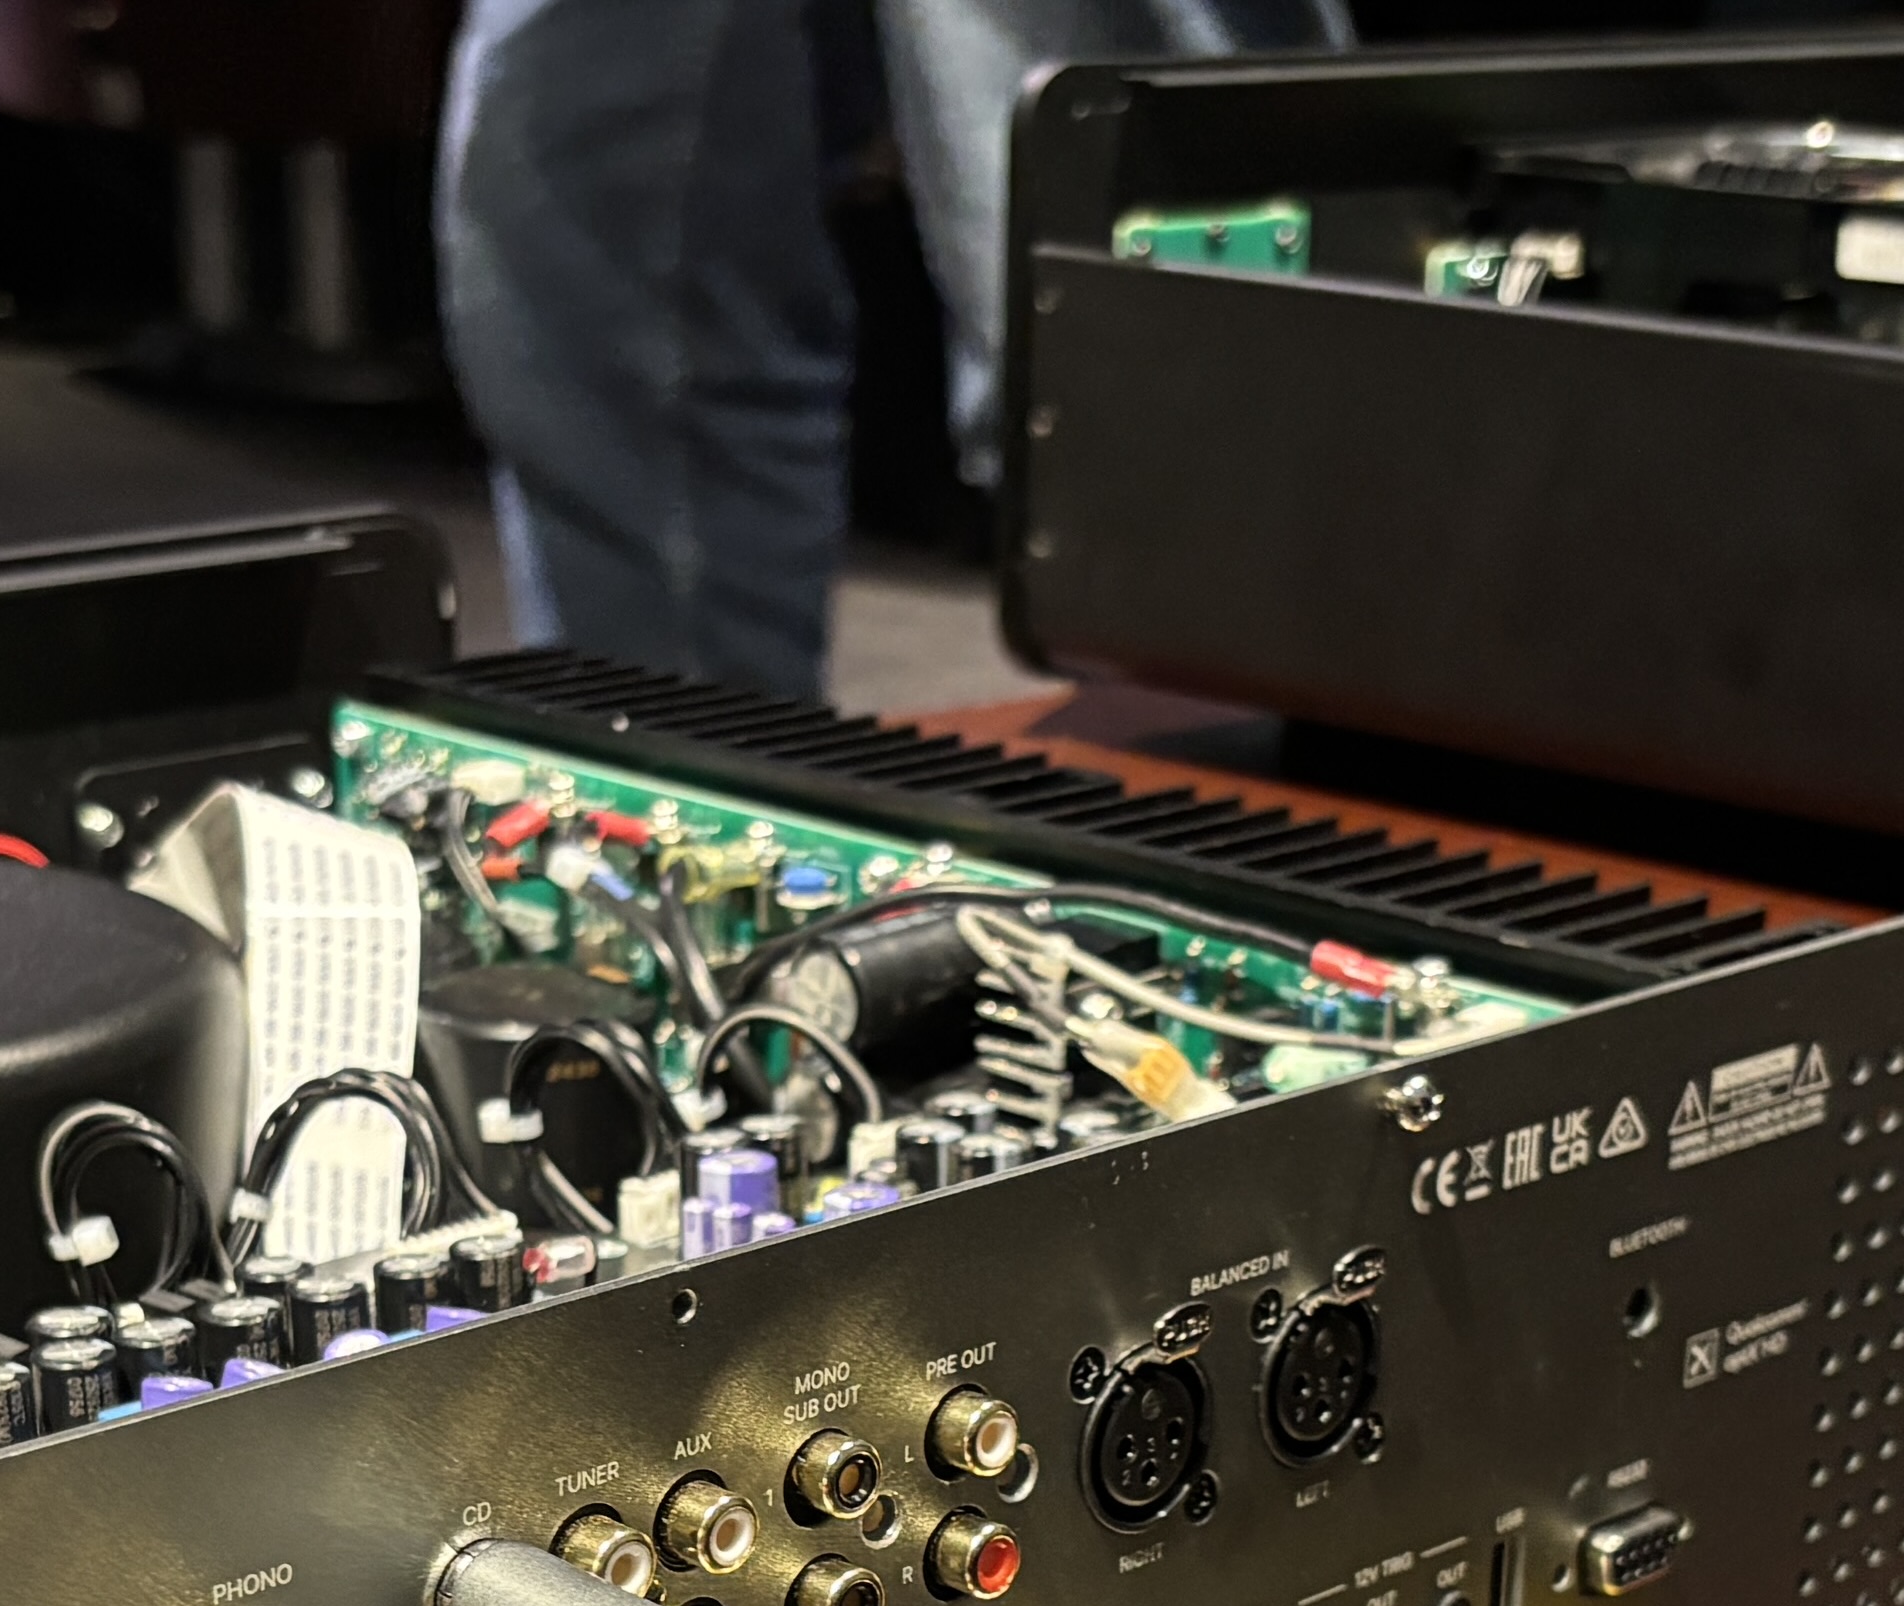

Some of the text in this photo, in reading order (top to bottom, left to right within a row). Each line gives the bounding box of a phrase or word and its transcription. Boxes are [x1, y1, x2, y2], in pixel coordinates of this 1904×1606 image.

[1552, 1105, 1593, 1141] UK
[1550, 1139, 1590, 1174] CA
[1190, 1250, 1290, 1297] BALANCED IN
[793, 1361, 852, 1395] MONO
[925, 1341, 997, 1382] PRE OUT
[782, 1383, 863, 1427] SUB OUT
[673, 1431, 713, 1462] AUX
[904, 1446, 914, 1463] L
[554, 1460, 621, 1497] TUNER
[461, 1500, 493, 1527] CD
[765, 1489, 774, 1507] 1
[902, 1565, 914, 1584] R
[1118, 1541, 1164, 1574] RIGHT
[212, 1563, 294, 1605] PHONO
[1436, 1561, 1468, 1589] OUT
